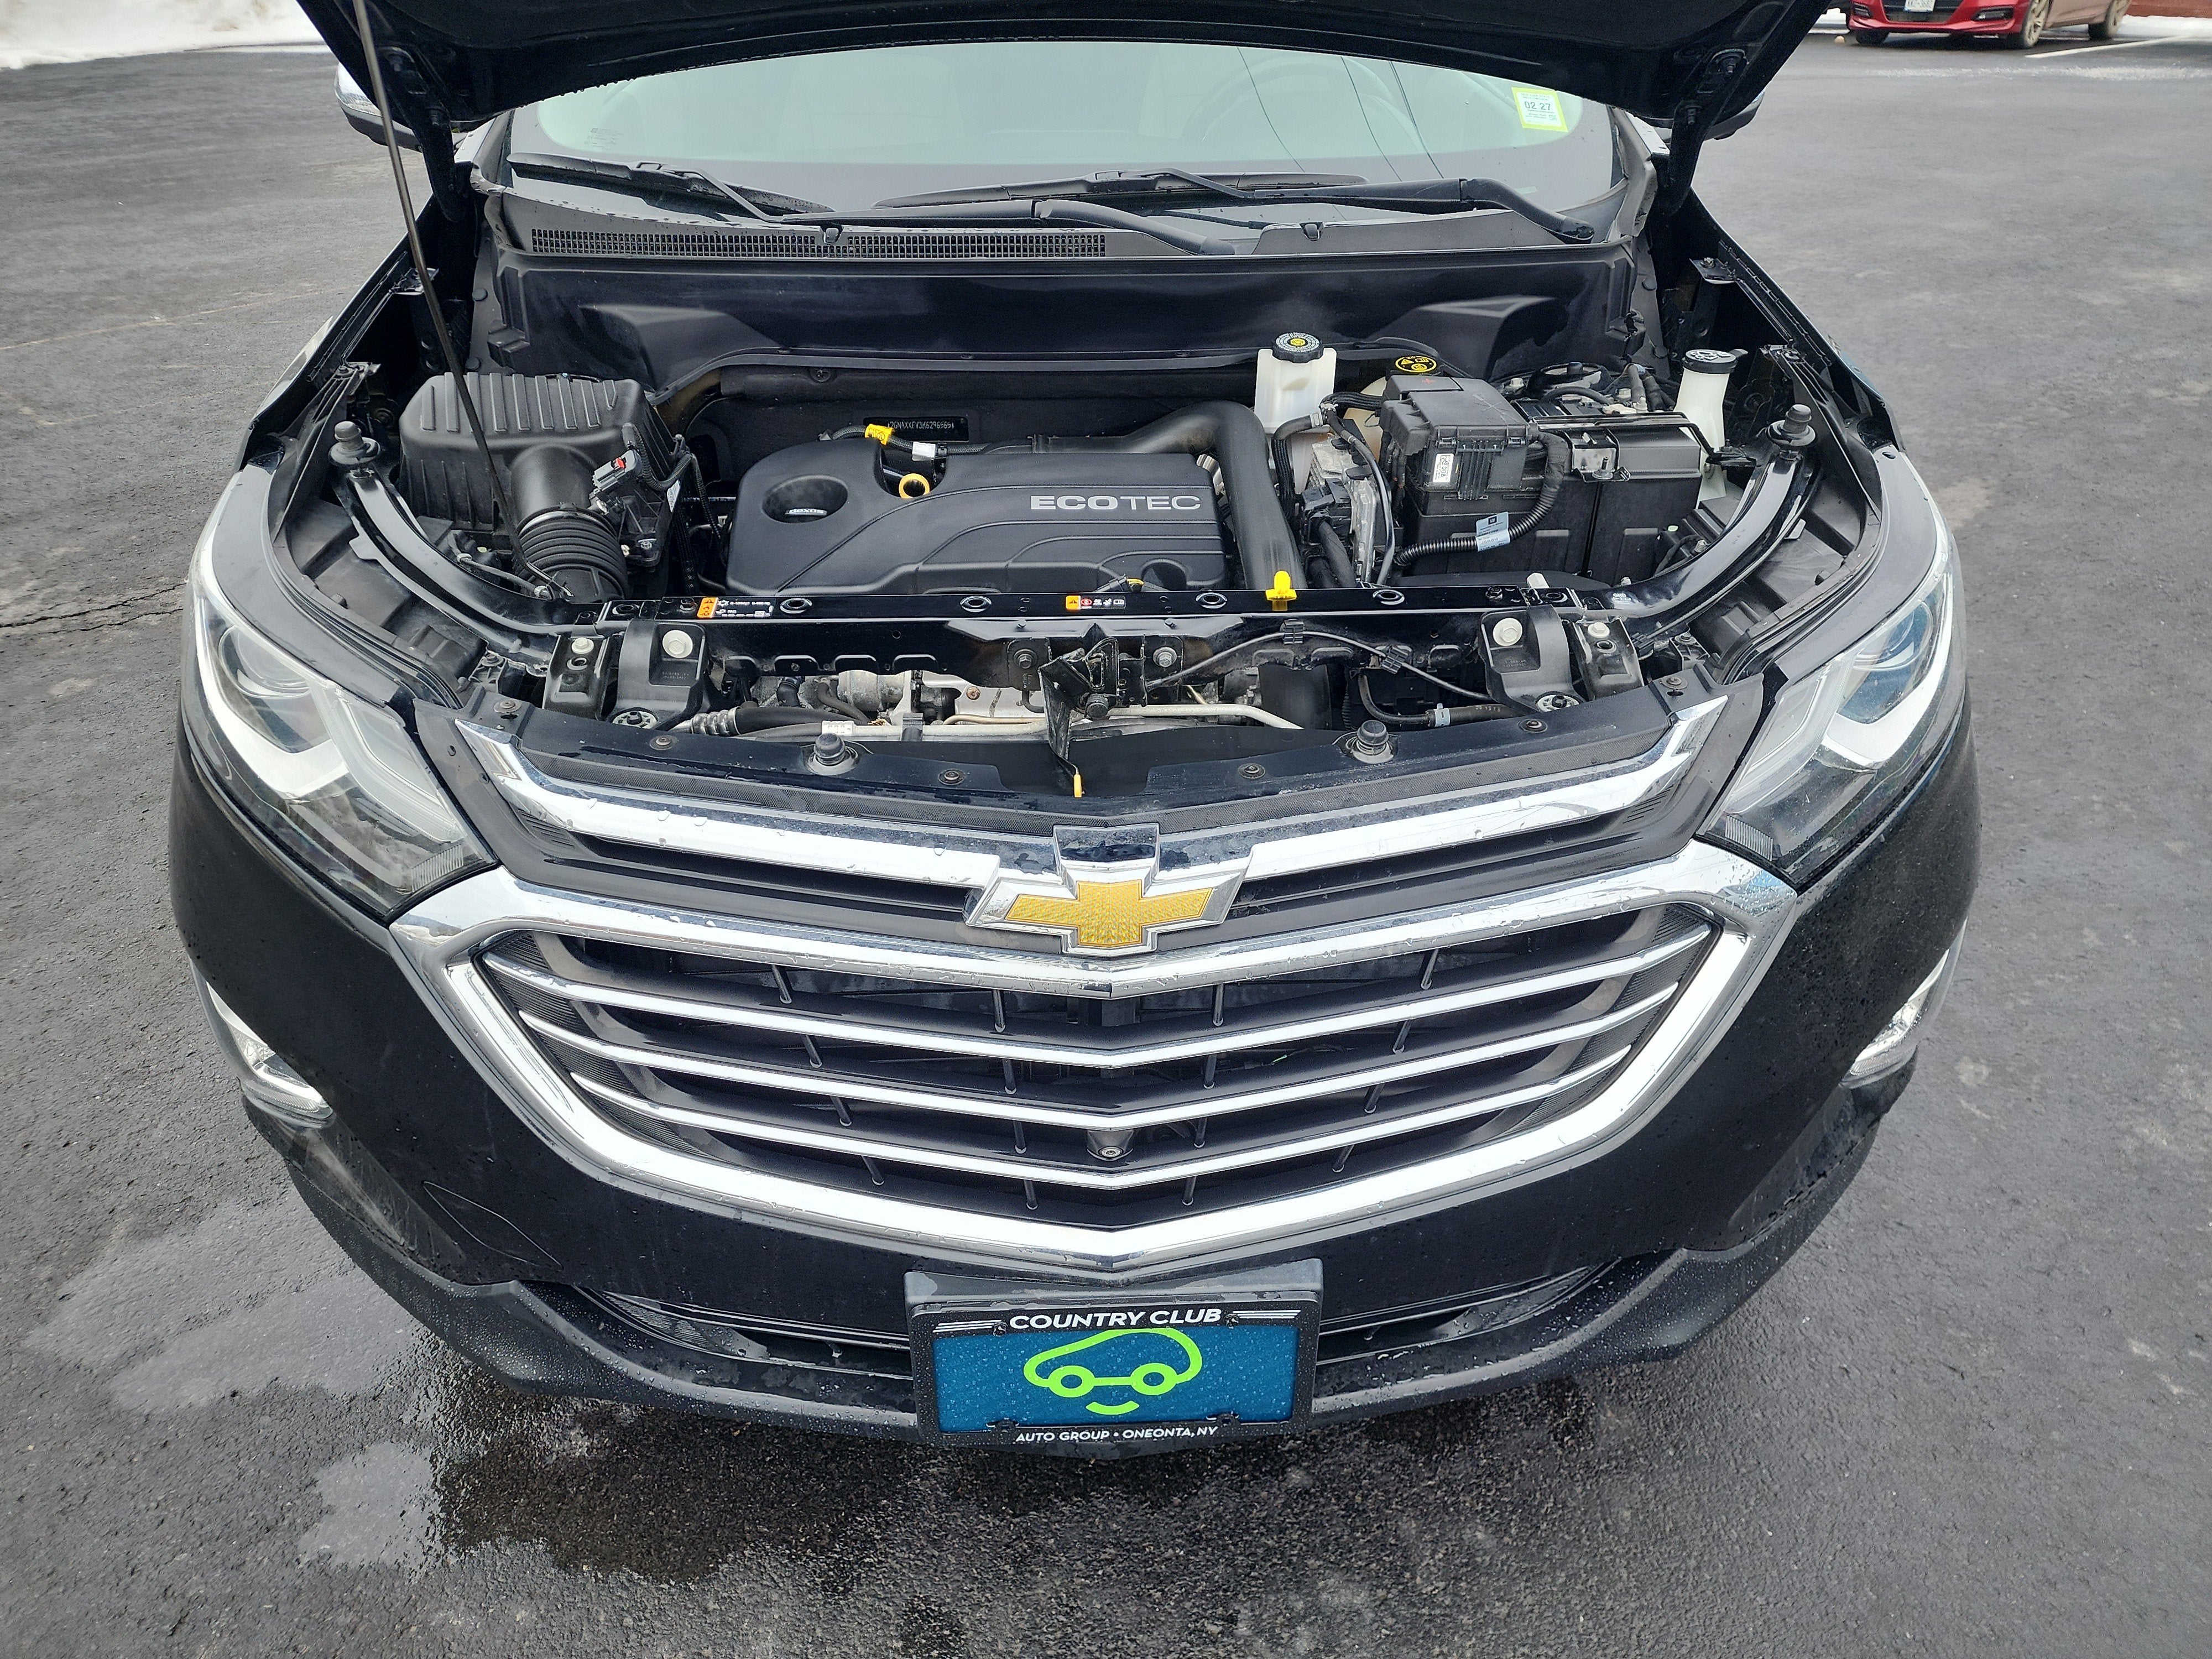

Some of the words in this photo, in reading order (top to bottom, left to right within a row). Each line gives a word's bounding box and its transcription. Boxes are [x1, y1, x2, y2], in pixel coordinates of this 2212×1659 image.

[1539, 102, 1551, 111] 27
[1031, 495, 1201, 510] ECOTEC
[1009, 1311, 1146, 1329] COUNTRY
[1149, 1308, 1222, 1324] CLUB
[1015, 1432, 1055, 1442] AUTO
[1059, 1430, 1110, 1441] GROUP
